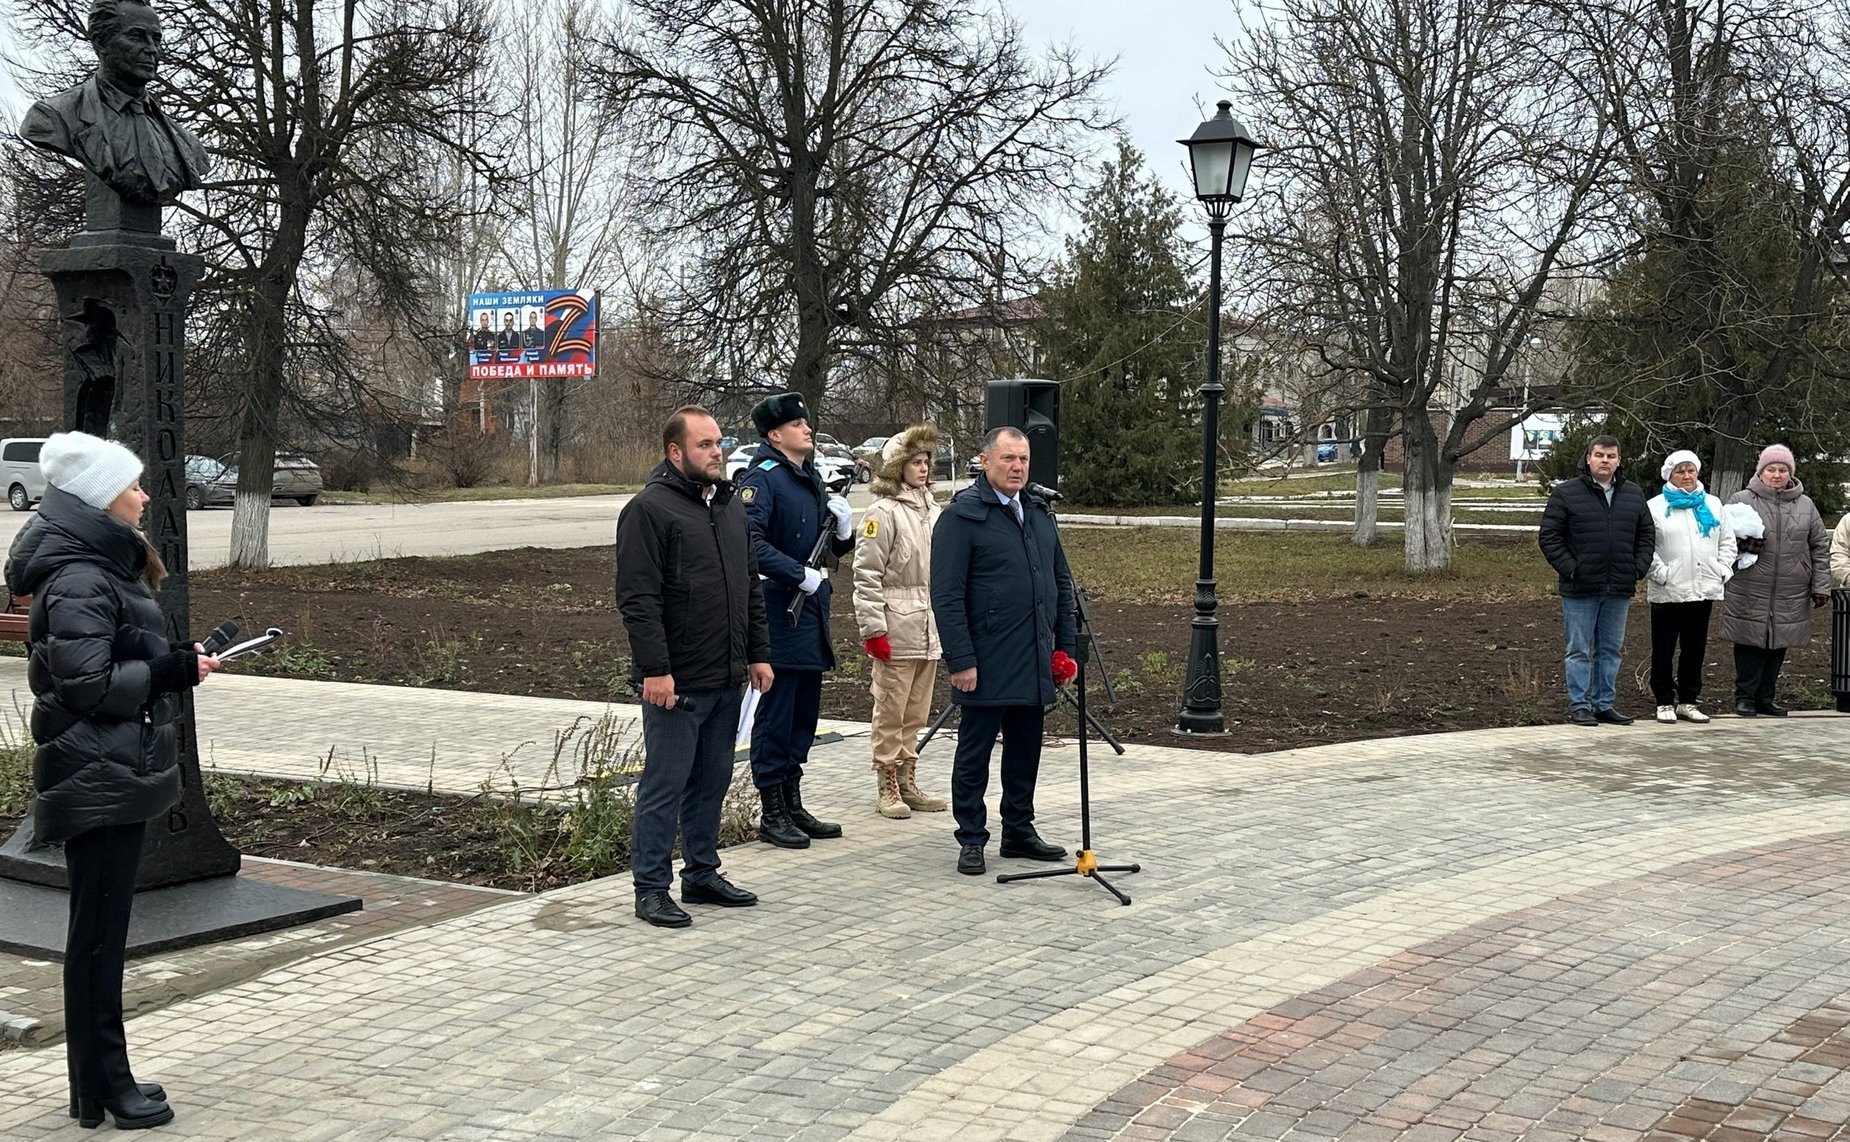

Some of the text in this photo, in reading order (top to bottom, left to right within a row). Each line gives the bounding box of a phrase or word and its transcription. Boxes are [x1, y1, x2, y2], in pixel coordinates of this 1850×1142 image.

[472, 295, 544, 306] НАШИ ЗЕМЛЯКИ
[472, 363, 593, 378] ПОБЕДА И ПАМЯТЬ
[154, 312, 182, 574] НИКОЛАЙ
